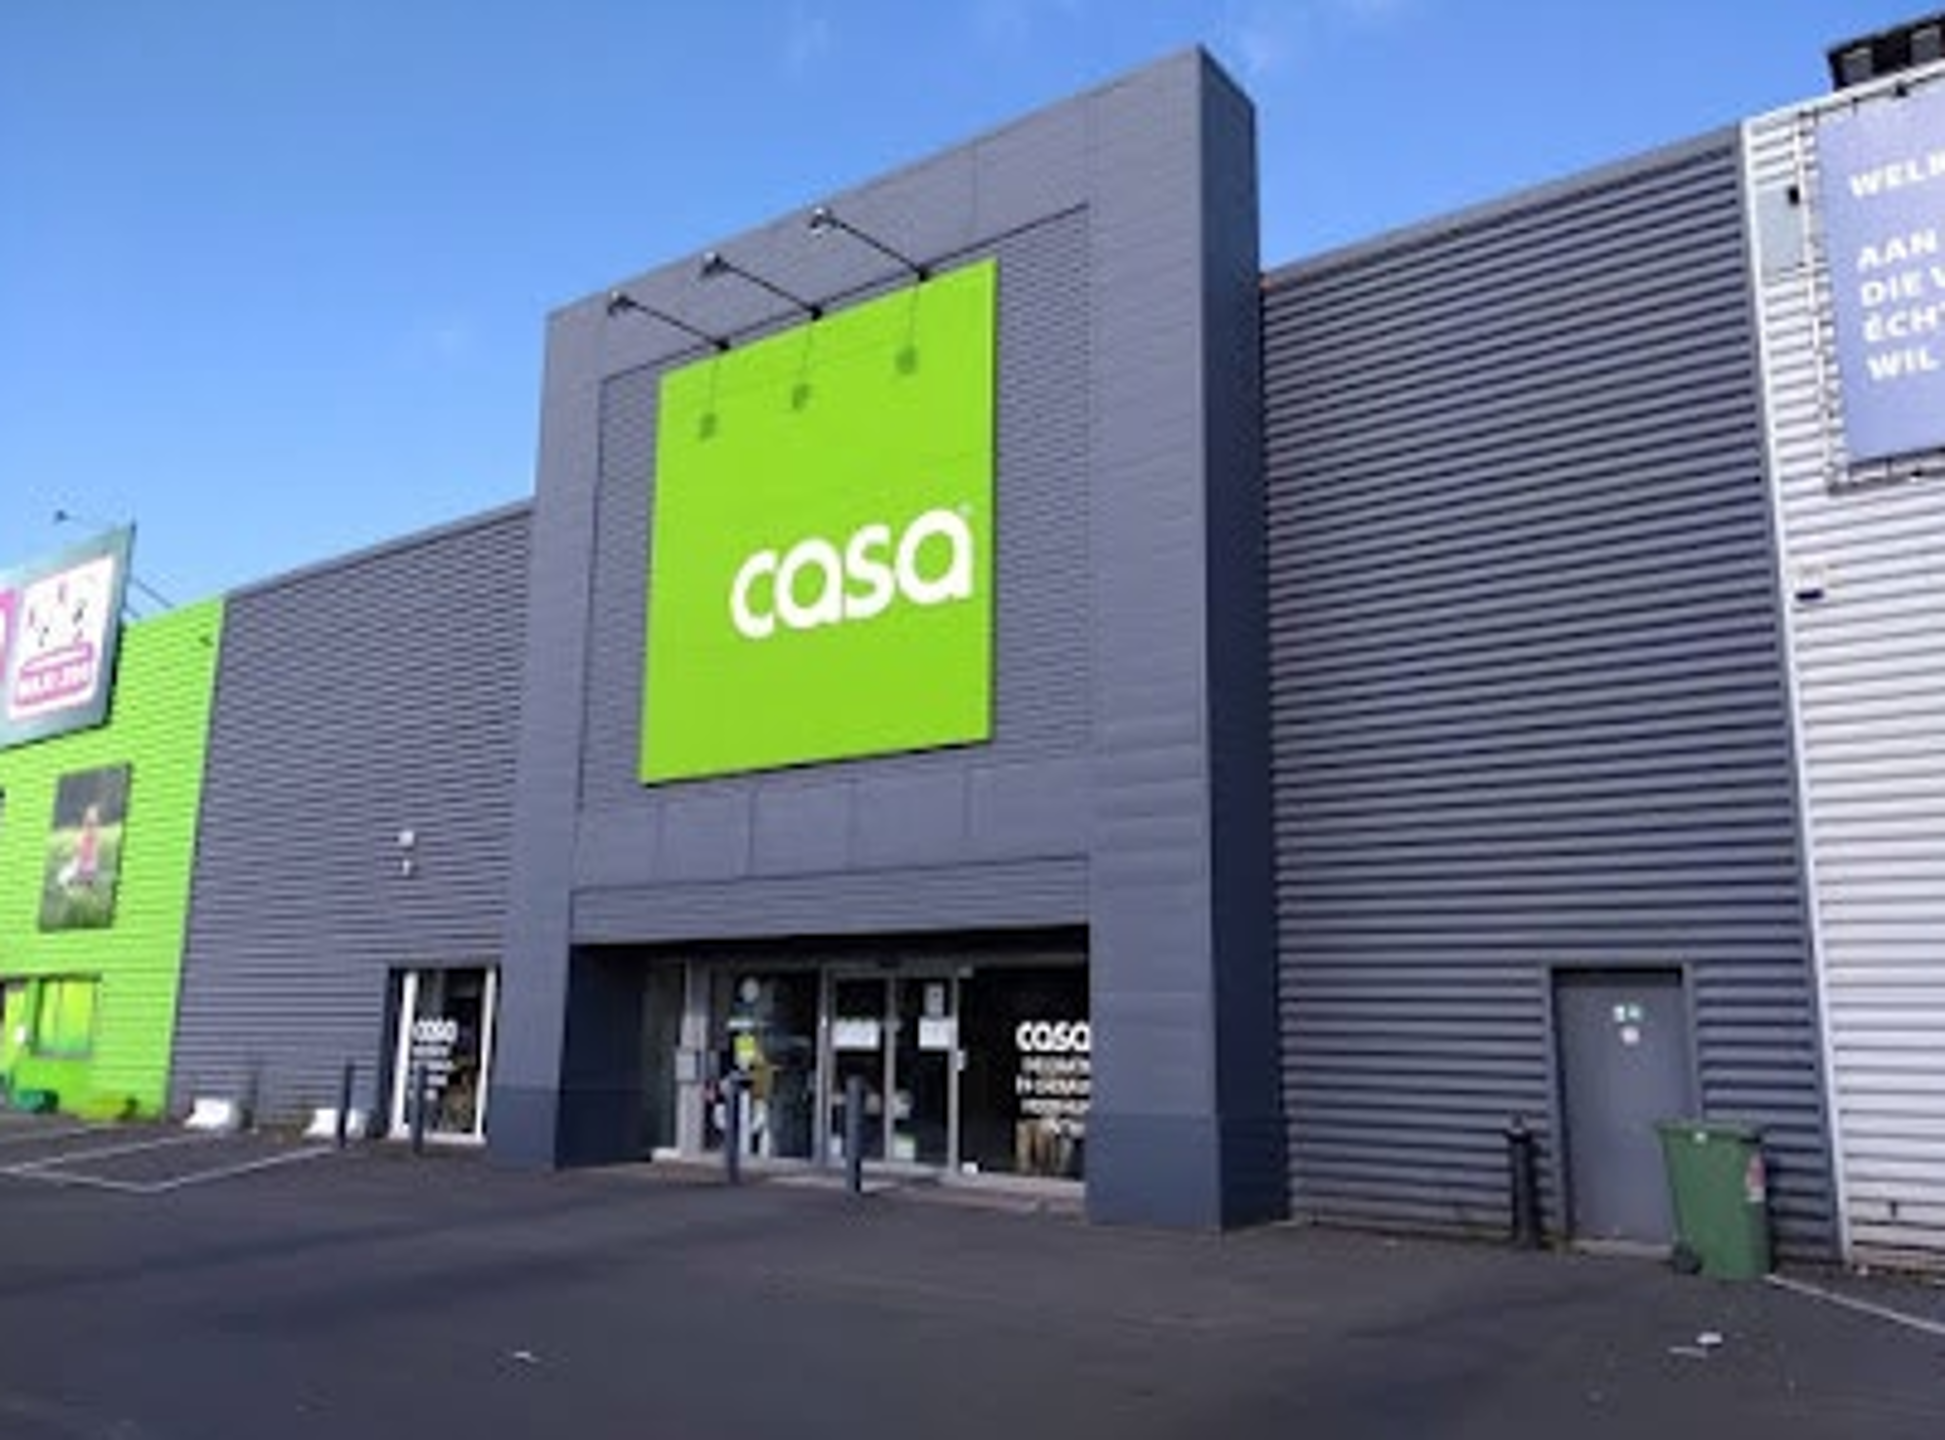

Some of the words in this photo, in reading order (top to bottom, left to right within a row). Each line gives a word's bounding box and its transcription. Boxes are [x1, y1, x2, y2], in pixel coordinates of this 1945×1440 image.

[1857, 228, 1937, 273] AAN
[1861, 270, 1921, 307] DIE
[1867, 348, 1940, 382] WIL
[730, 506, 973, 639] casa
[1016, 1020, 1090, 1051] casa
